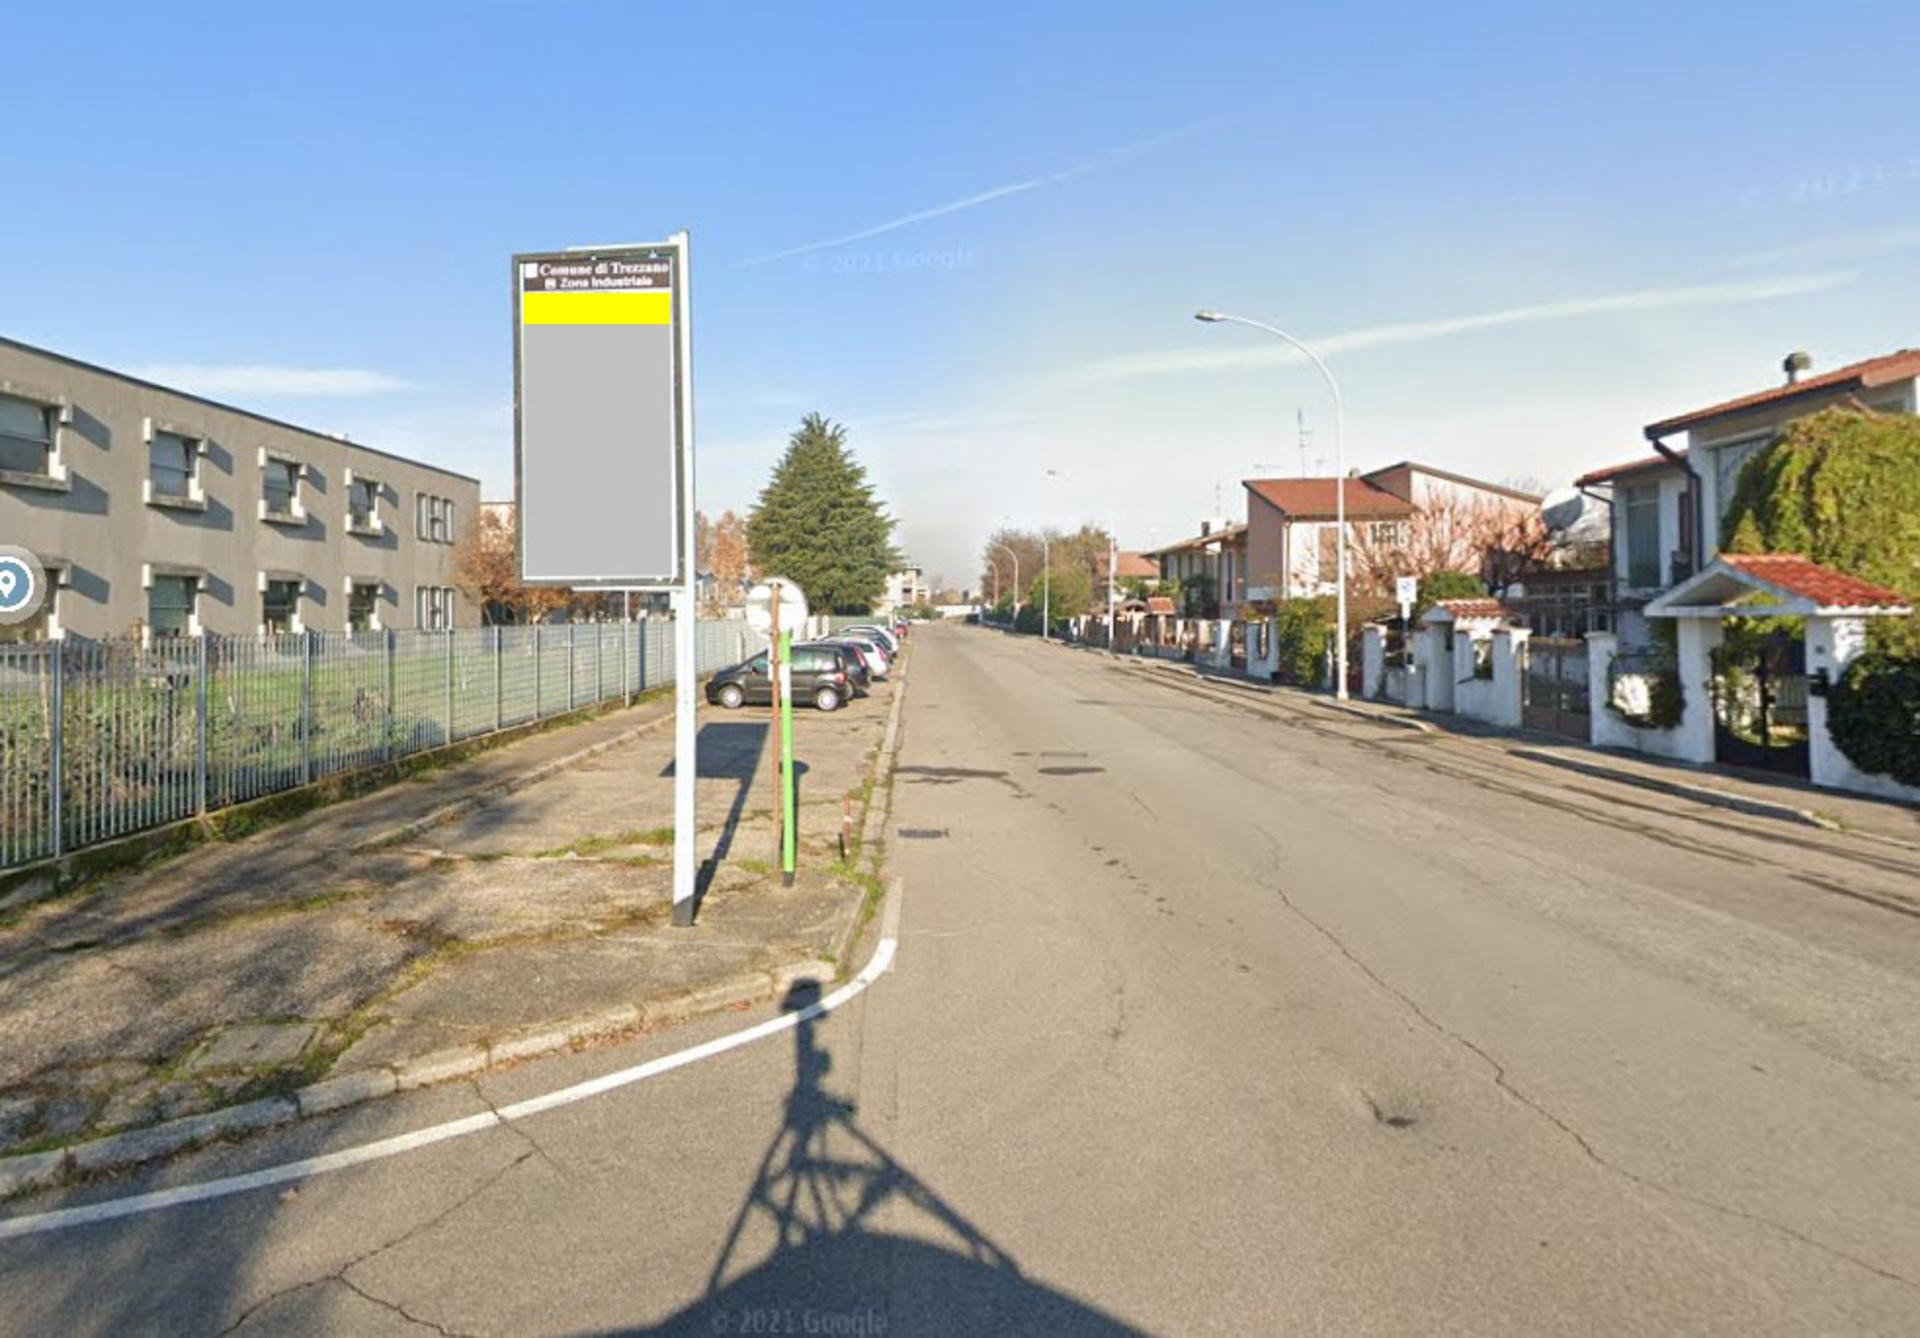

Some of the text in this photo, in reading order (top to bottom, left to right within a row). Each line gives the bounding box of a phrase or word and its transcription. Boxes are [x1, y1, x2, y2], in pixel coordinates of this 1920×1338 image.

[540, 260, 669, 276] Comune di Trezzano
[559, 275, 654, 289] Zona Industriale
